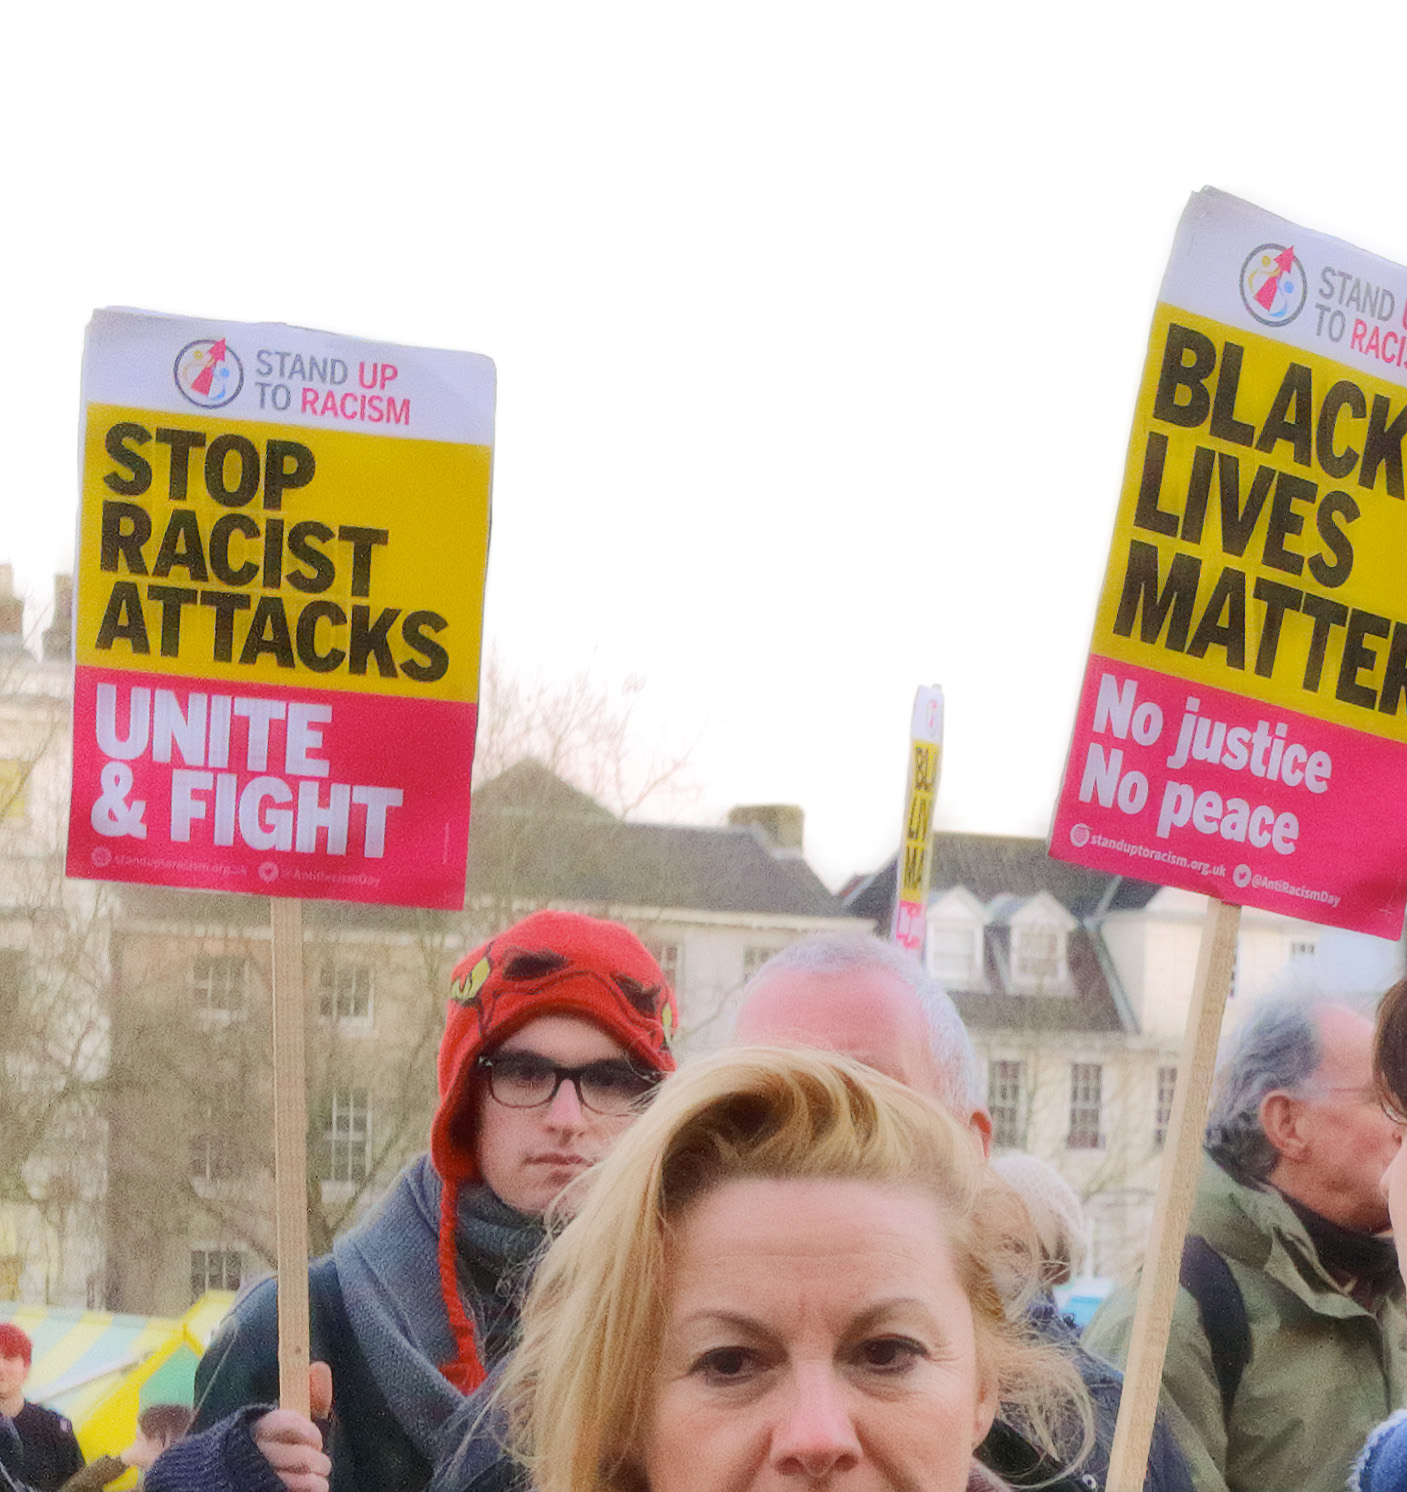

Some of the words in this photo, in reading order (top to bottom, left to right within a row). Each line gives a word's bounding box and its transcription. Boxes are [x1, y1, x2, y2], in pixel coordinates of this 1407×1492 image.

[1314, 304, 1346, 344] TO
[1317, 266, 1396, 321] STAND
[256, 349, 347, 385] STAND
[358, 361, 398, 390] UP
[256, 381, 291, 411] TO
[301, 387, 410, 425] RACISM
[102, 422, 316, 511] STOP
[1133, 431, 1361, 589] LIVES
[100, 501, 389, 598] RACIST
[95, 581, 449, 683] ATTACKS
[95, 683, 332, 778] UNITE
[1092, 674, 1162, 746] No
[1167, 696, 1333, 794] justice
[90, 760, 148, 841] &
[170, 770, 403, 859] FIGHT
[1078, 743, 1149, 813] No
[1156, 773, 1300, 855] peace
[1091, 834, 1227, 877] standuptoracism.org.uk
[1251, 874, 1341, 909] @AntiRacismDay
